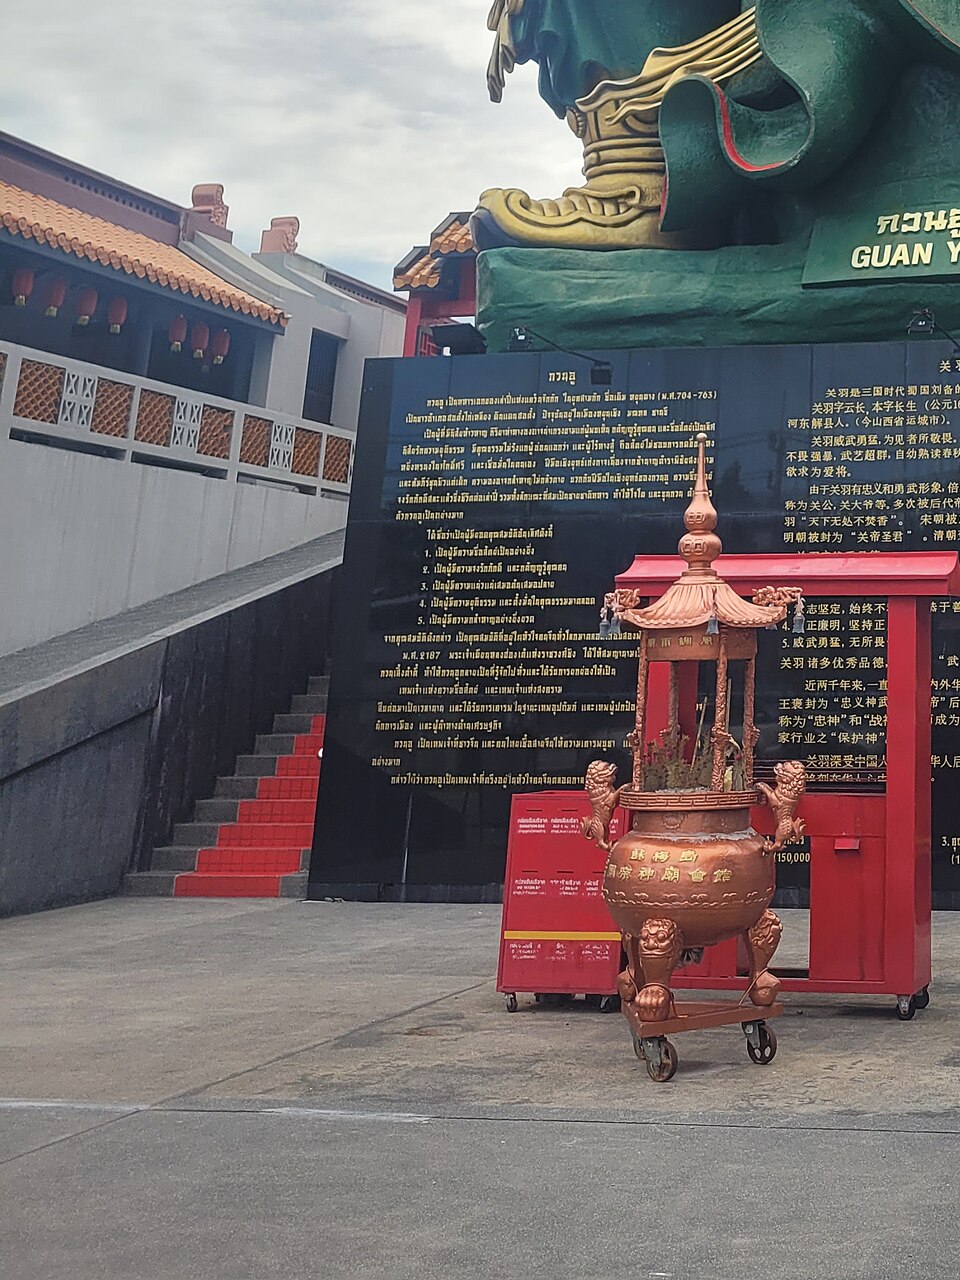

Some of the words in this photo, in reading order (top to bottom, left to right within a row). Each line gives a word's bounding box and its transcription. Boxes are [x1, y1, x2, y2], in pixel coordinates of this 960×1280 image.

[850, 242, 934, 269] GUAN
[548, 371, 576, 385] กวนอู
[941, 836, 950, 847] 3.
